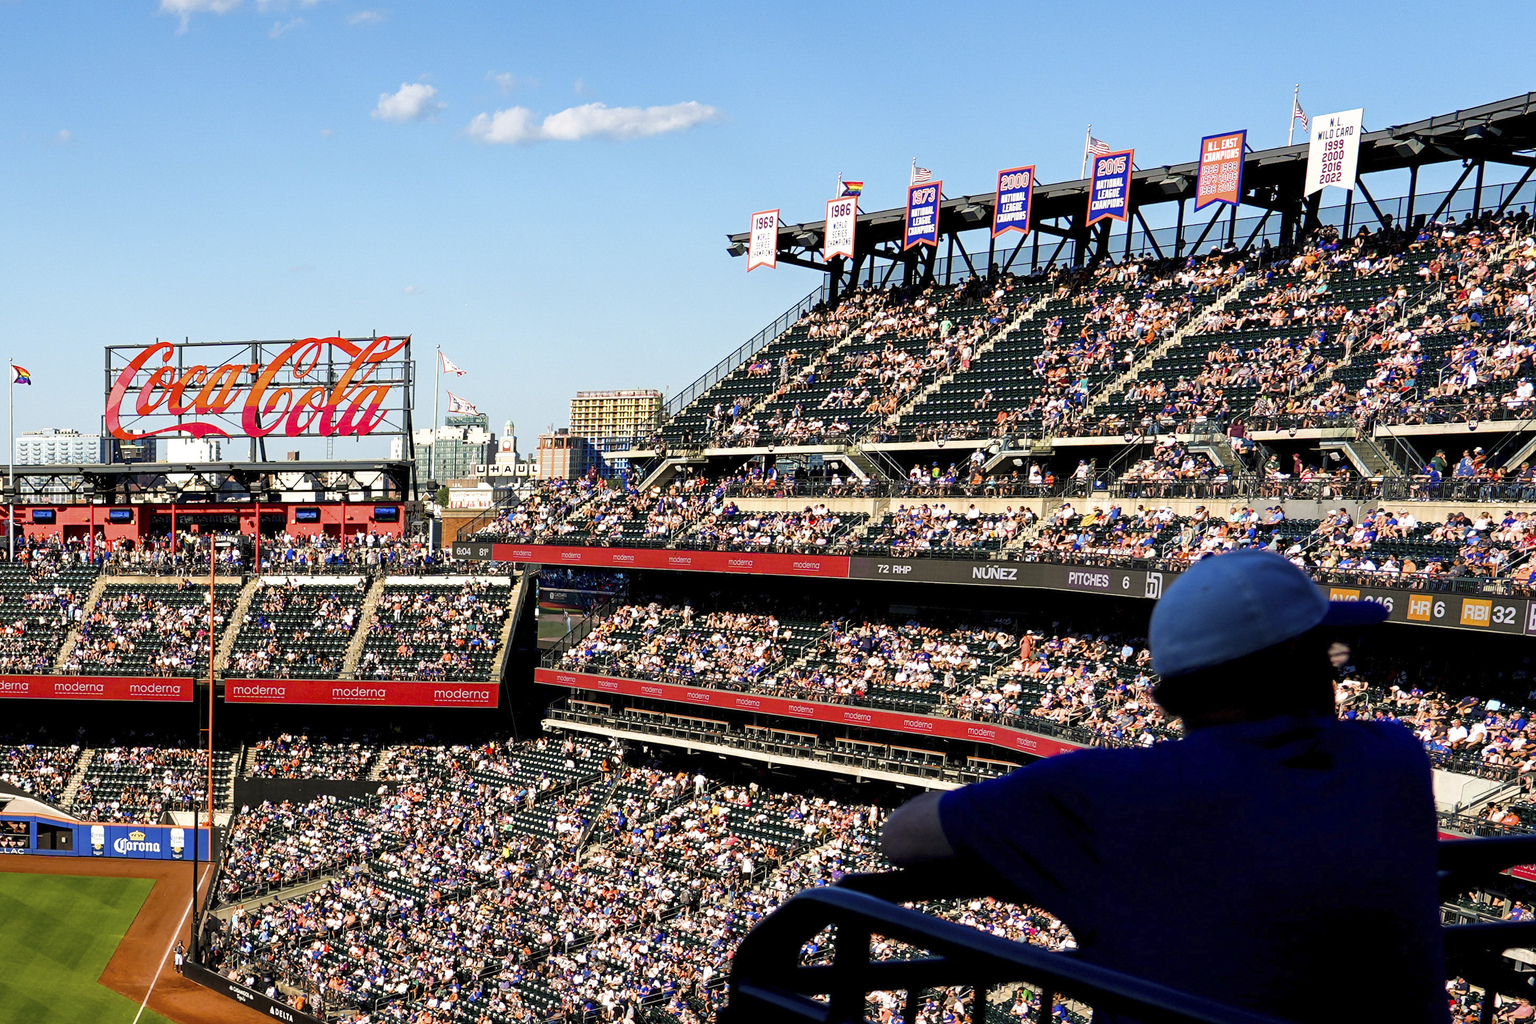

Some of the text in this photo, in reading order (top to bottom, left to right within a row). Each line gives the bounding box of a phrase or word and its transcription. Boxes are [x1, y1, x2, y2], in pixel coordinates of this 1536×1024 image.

[1318, 126, 1354, 141] WILD CARD
[1221, 137, 1238, 150] EAST
[1324, 139, 1344, 151] 1999
[1203, 148, 1240, 162] CHAMPIONS
[1322, 150, 1344, 162] 2000
[1097, 156, 1127, 177] 2015
[1322, 161, 1342, 173] 2016
[1000, 171, 1030, 191] 2000
[1319, 172, 1342, 184] 2022
[911, 187, 935, 206] 1973
[831, 202, 852, 218] 1986
[755, 215, 774, 230] 1969
[105, 333, 412, 440] Coca-Cola
[456, 547, 471, 556] 6:04
[877, 564, 912, 574] 72 RHP
[972, 565, 1017, 580] NÚÑEZ
[1068, 571, 1110, 587] PITCHES
[1122, 576, 1130, 589] 6
[1409, 600, 1446, 618] HR 6
[1463, 604, 1490, 621] RBI
[1491, 605, 1517, 625] 32
[54, 680, 104, 693] moderna
[129, 682, 181, 694] moderna
[233, 685, 286, 695] moderna
[332, 687, 386, 697] moderna
[434, 688, 490, 699] moderna
[113, 837, 161, 854] Corona
[274, 1008, 294, 1023] DELTA
